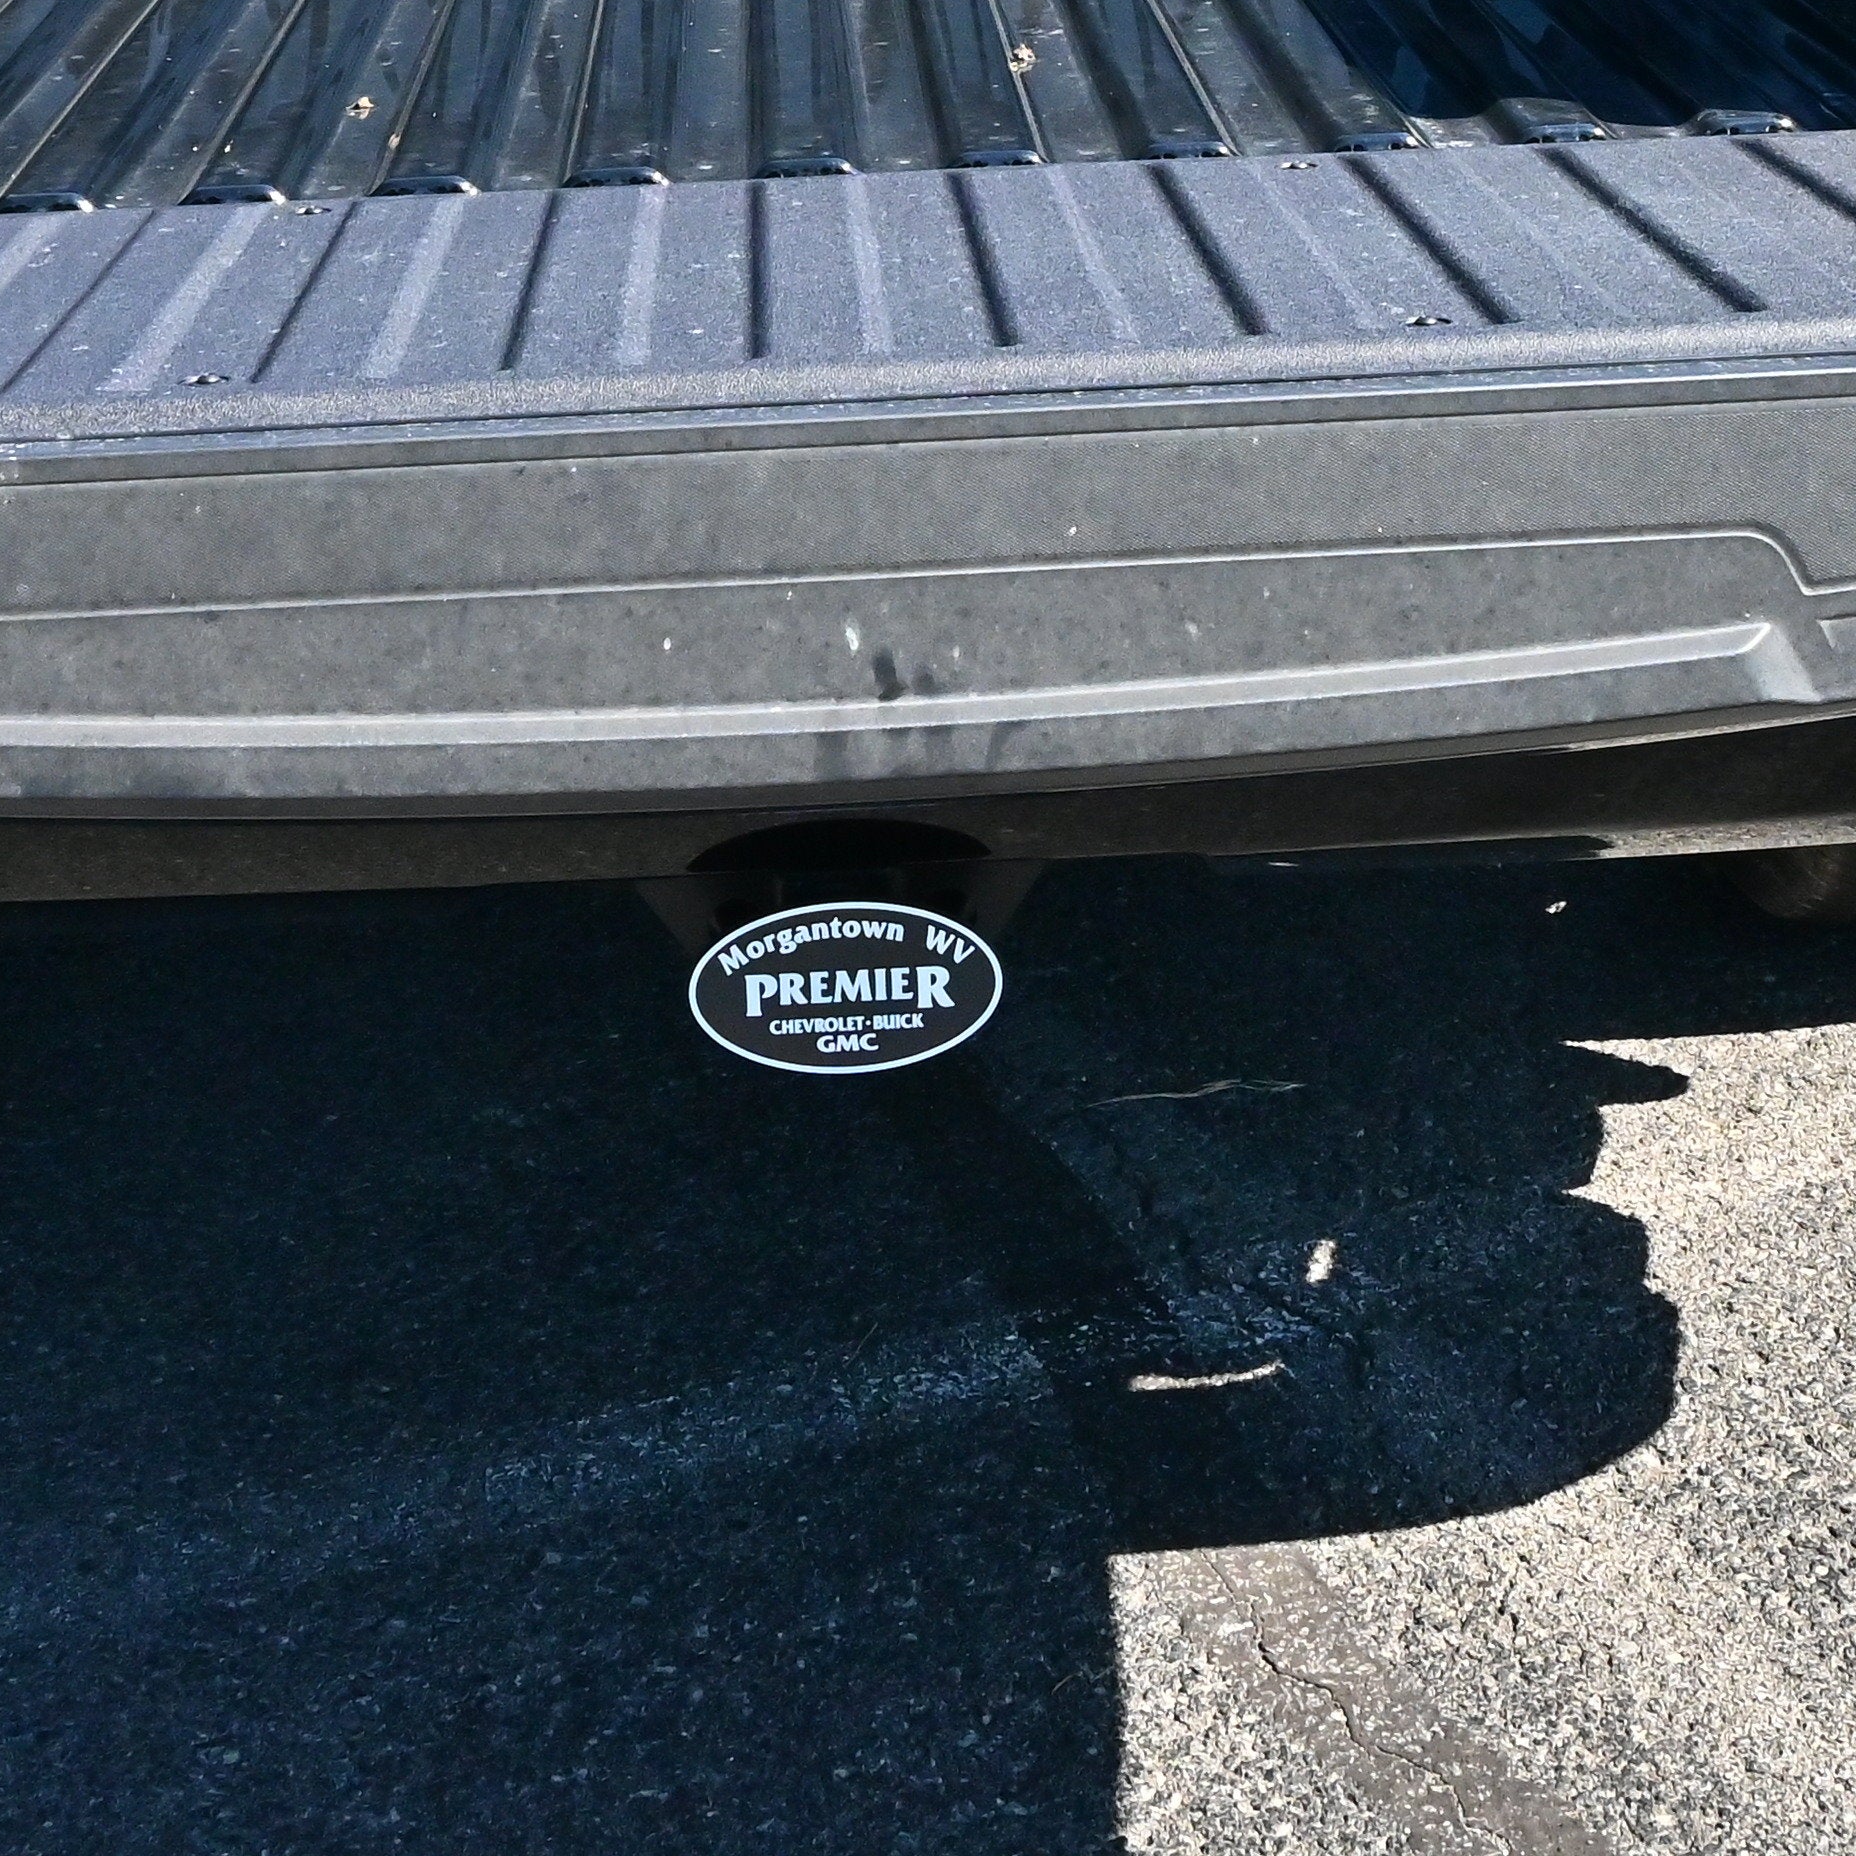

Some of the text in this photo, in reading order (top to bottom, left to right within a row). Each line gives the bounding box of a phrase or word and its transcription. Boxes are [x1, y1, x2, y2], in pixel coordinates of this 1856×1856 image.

[717, 916, 975, 976] Morgantown WV
[744, 965, 955, 1017] PREMIER
[816, 1033, 879, 1053] GMC
